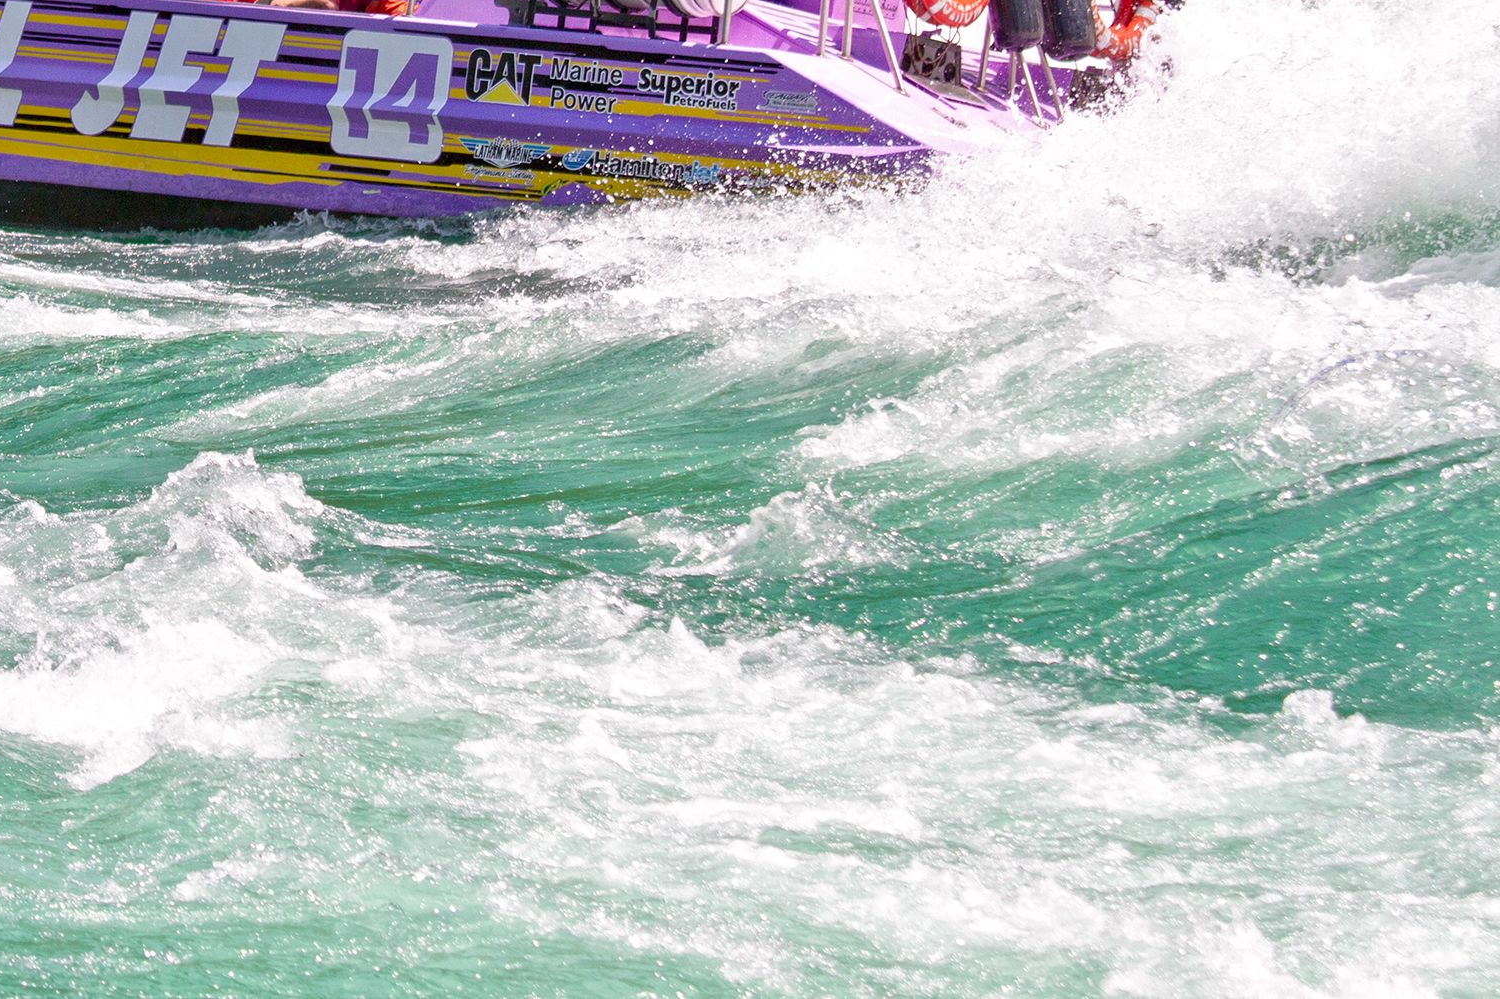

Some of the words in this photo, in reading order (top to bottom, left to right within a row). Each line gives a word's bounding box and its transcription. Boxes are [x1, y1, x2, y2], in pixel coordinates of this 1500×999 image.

[70, 9, 287, 147] JET
[343, 45, 438, 145] 14
[464, 48, 543, 106] CAT
[550, 57, 624, 87] Marine
[636, 67, 740, 106] Superior
[549, 86, 618, 114] Power
[671, 94, 737, 112] PetroFuels
[474, 144, 503, 160] LATHAM
[504, 145, 534, 164] MARINE
